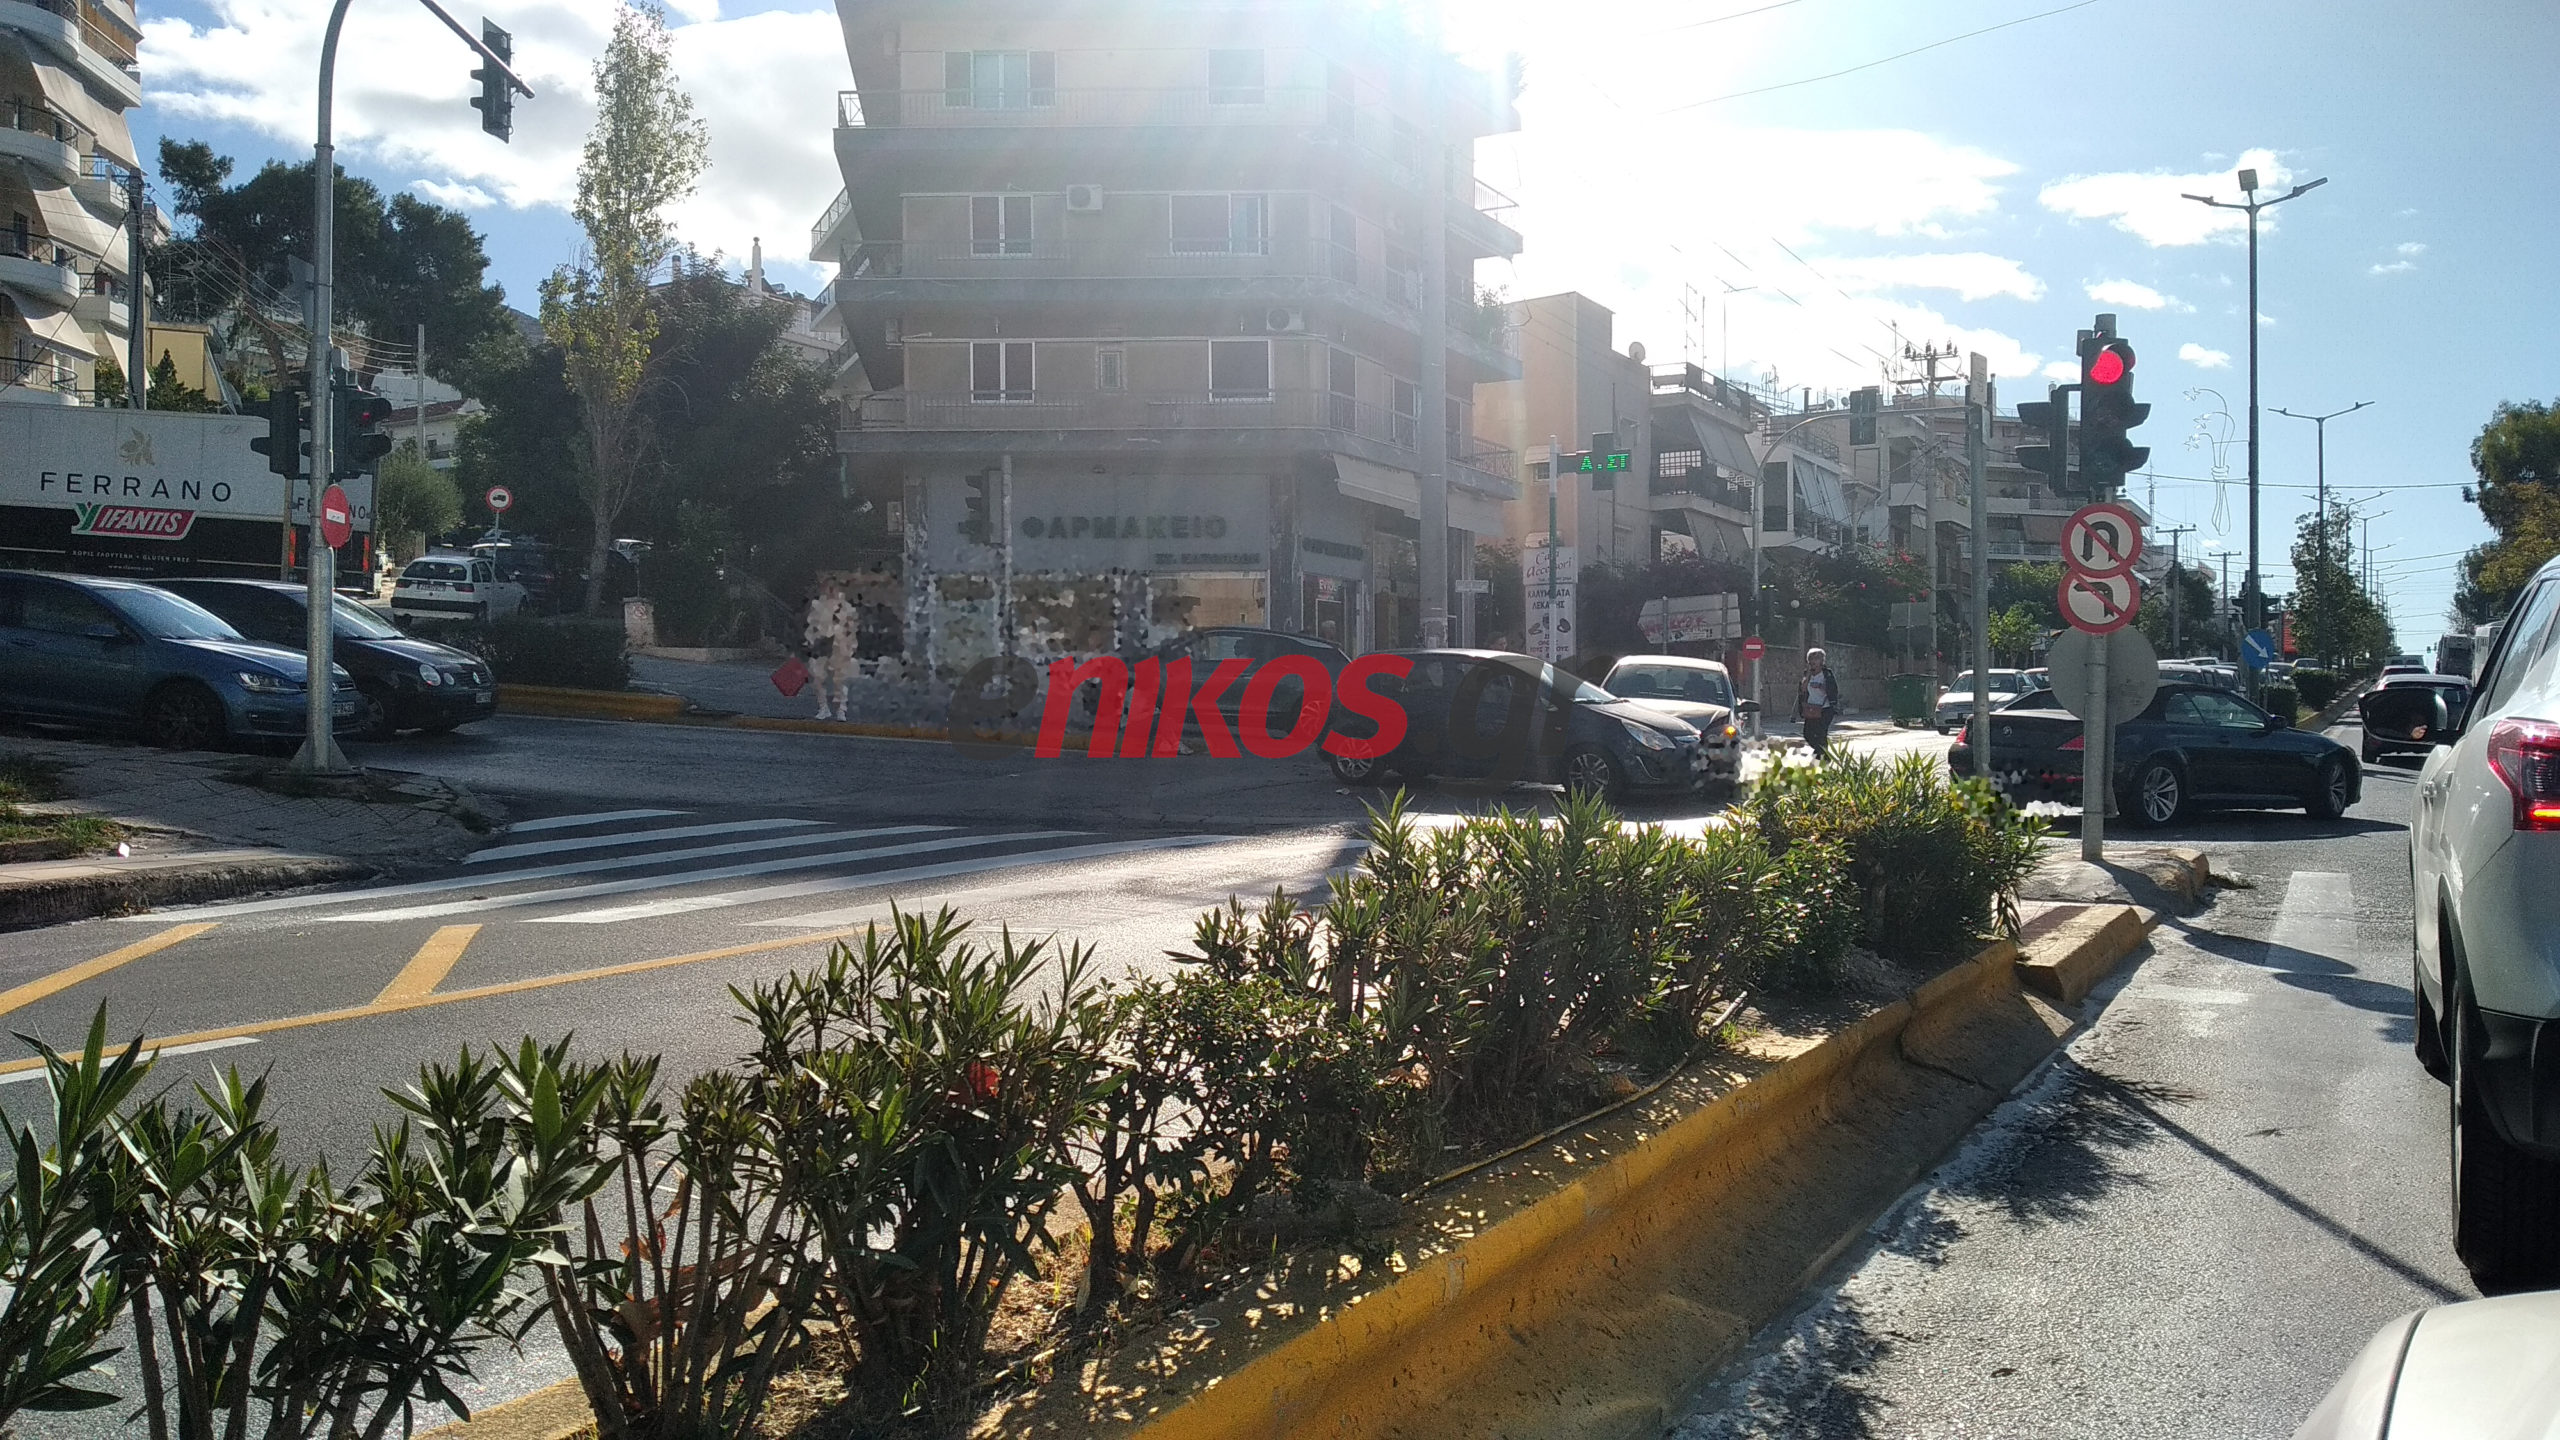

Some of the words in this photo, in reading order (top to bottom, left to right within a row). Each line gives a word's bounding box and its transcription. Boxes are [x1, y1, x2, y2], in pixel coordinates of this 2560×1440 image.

[39, 471, 232, 502] FERRANO
[1020, 515, 1227, 539] ΦΑΡΜΑΚΕΙΟ
[1527, 588, 1571, 599] ΚΑΛΥΜΑΤΑ
